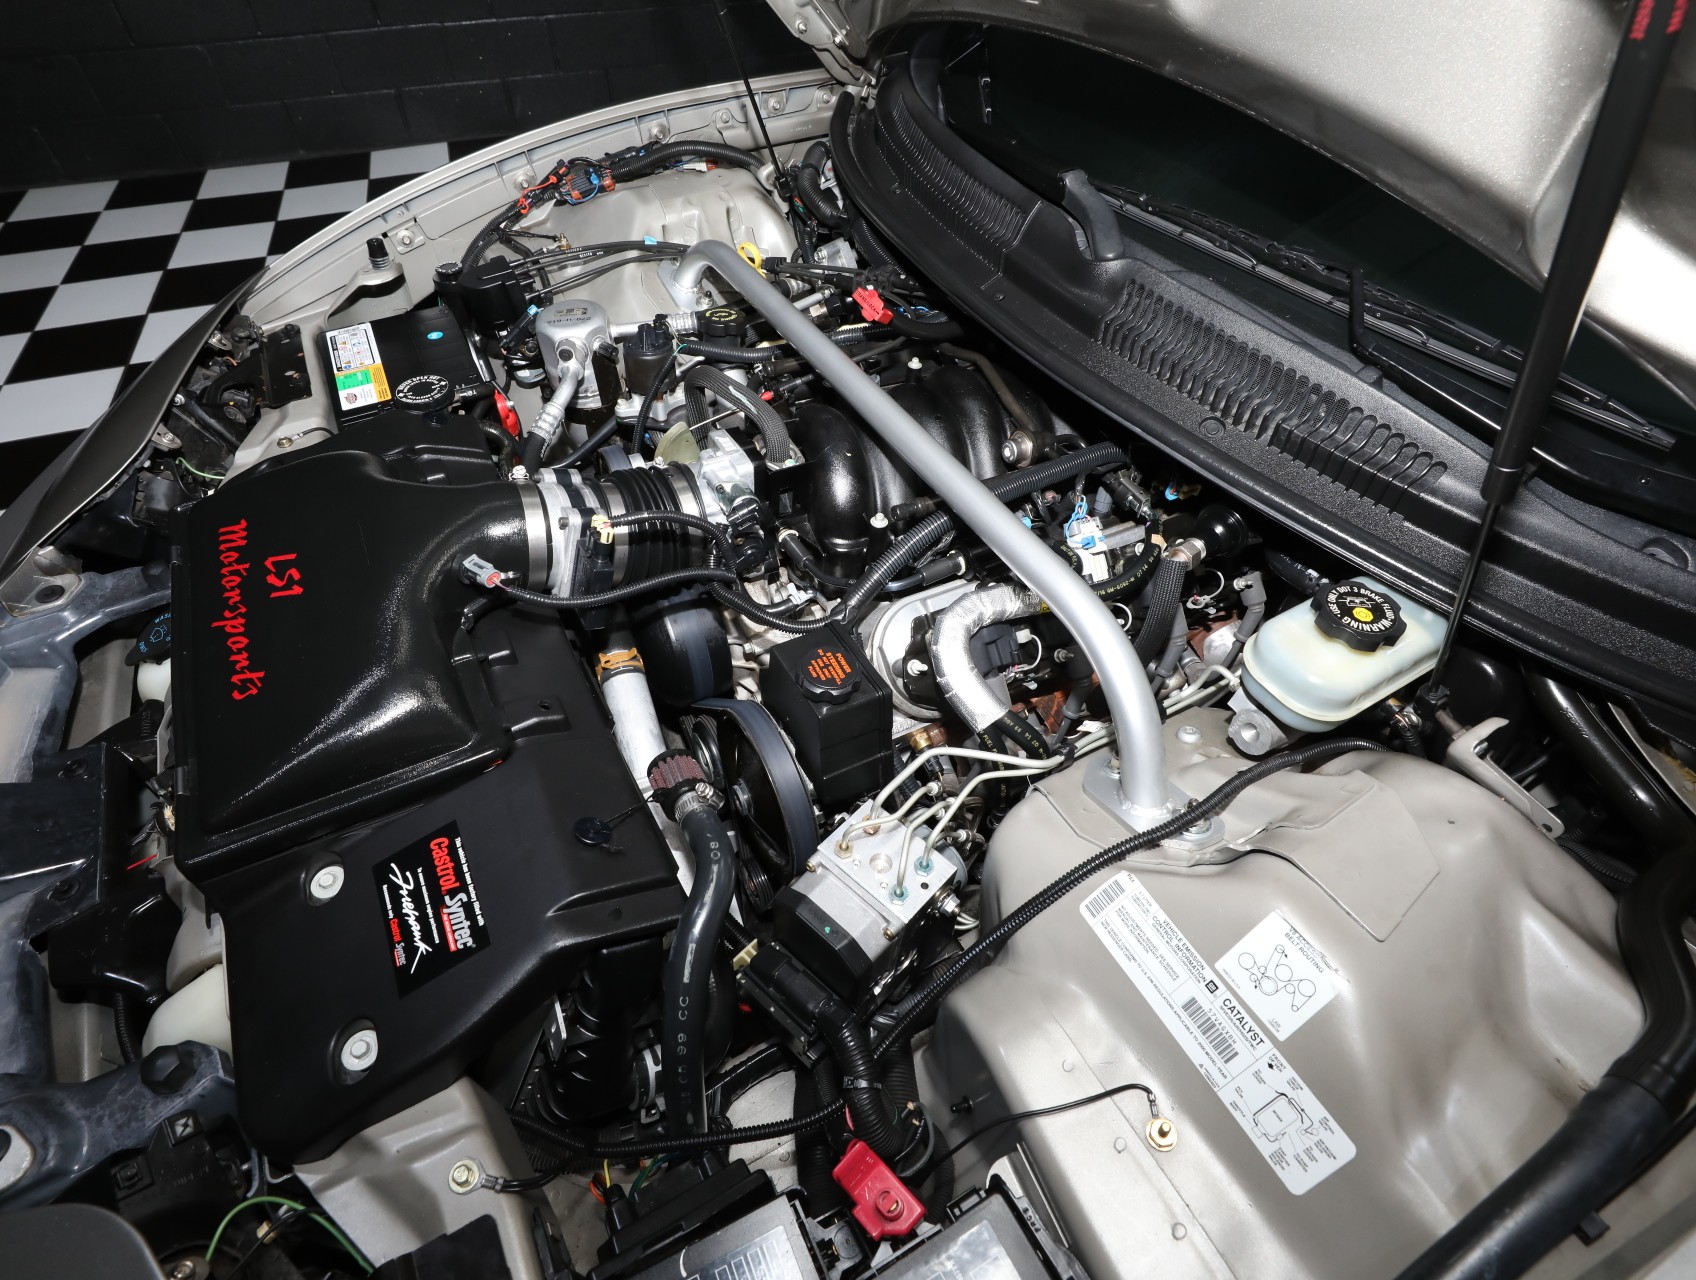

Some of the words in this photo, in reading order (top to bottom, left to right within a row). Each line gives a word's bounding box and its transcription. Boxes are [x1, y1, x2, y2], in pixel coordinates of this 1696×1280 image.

[264, 553, 306, 599] LS1
[1338, 585, 1352, 593] DOT
[1360, 587, 1384, 603] BRAKE
[210, 518, 267, 701] Motorsports
[1340, 615, 1393, 631] WARNING
[822, 655, 830, 665] NOT
[825, 650, 845, 679] STEERING
[835, 651, 851, 674] POWER
[430, 837, 460, 895] Castrol
[390, 917, 402, 943] Castrol
[442, 892, 474, 950] Syntec
[1106, 929, 1124, 951] PASSENGER
[395, 941, 407, 967] Syntec
[1117, 907, 1130, 923] MANUAL
[1129, 922, 1137, 932] AND
[1136, 931, 1159, 959] MAINTENANCE
[1158, 959, 1176, 982] SCHEDULE
[1124, 910, 1147, 937] ADJUSTMENTS
[1158, 953, 1166, 962] SEE
[1164, 961, 1180, 979] SERVICE
[1151, 914, 1175, 942] CONTROL
[1173, 942, 1207, 983] INFORMATION
[1151, 922, 1166, 940] GENERAL
[1164, 939, 1179, 956] MOTORS
[1177, 955, 1201, 984] CORPORATION
[1161, 918, 1183, 943] VEHICLE
[1180, 942, 1206, 971] EMISSION
[1283, 931, 1300, 948] BELT
[1297, 946, 1324, 973] ROUTING
[1102, 918, 1111, 927] THIS
[1108, 926, 1122, 942] VEHICLE
[1120, 941, 1138, 963] CONFORMS
[1152, 982, 1175, 1011] REGULATIONS
[1172, 1009, 1194, 1035] APPLICABLE
[1192, 1034, 1199, 1042] TO
[1221, 996, 1265, 1048] CATALYST
[1267, 1055, 1275, 1063] OF
[1271, 1052, 1286, 1070] FRONT
